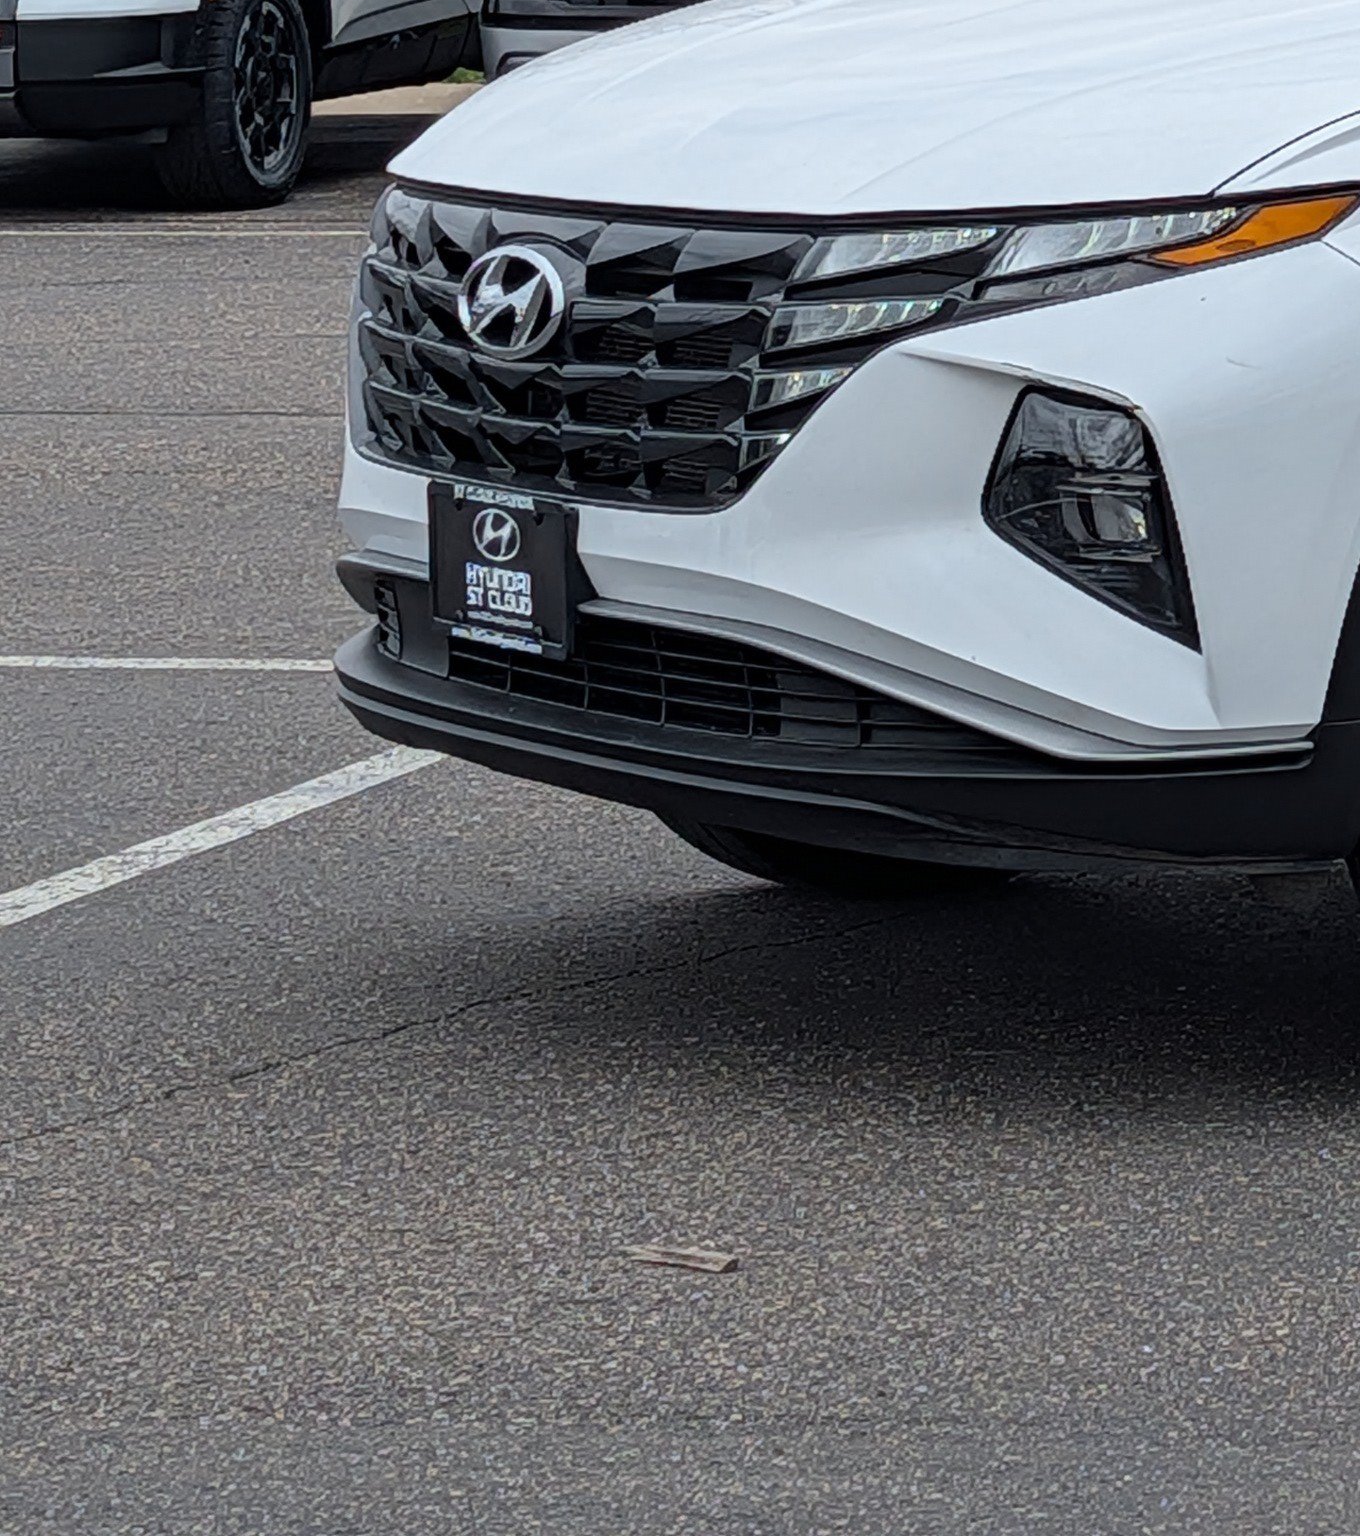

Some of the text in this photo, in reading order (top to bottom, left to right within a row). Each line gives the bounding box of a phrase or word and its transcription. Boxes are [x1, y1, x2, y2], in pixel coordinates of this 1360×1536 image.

[465, 562, 532, 595] HYUNDAI
[466, 585, 533, 616] ST CLOUD
